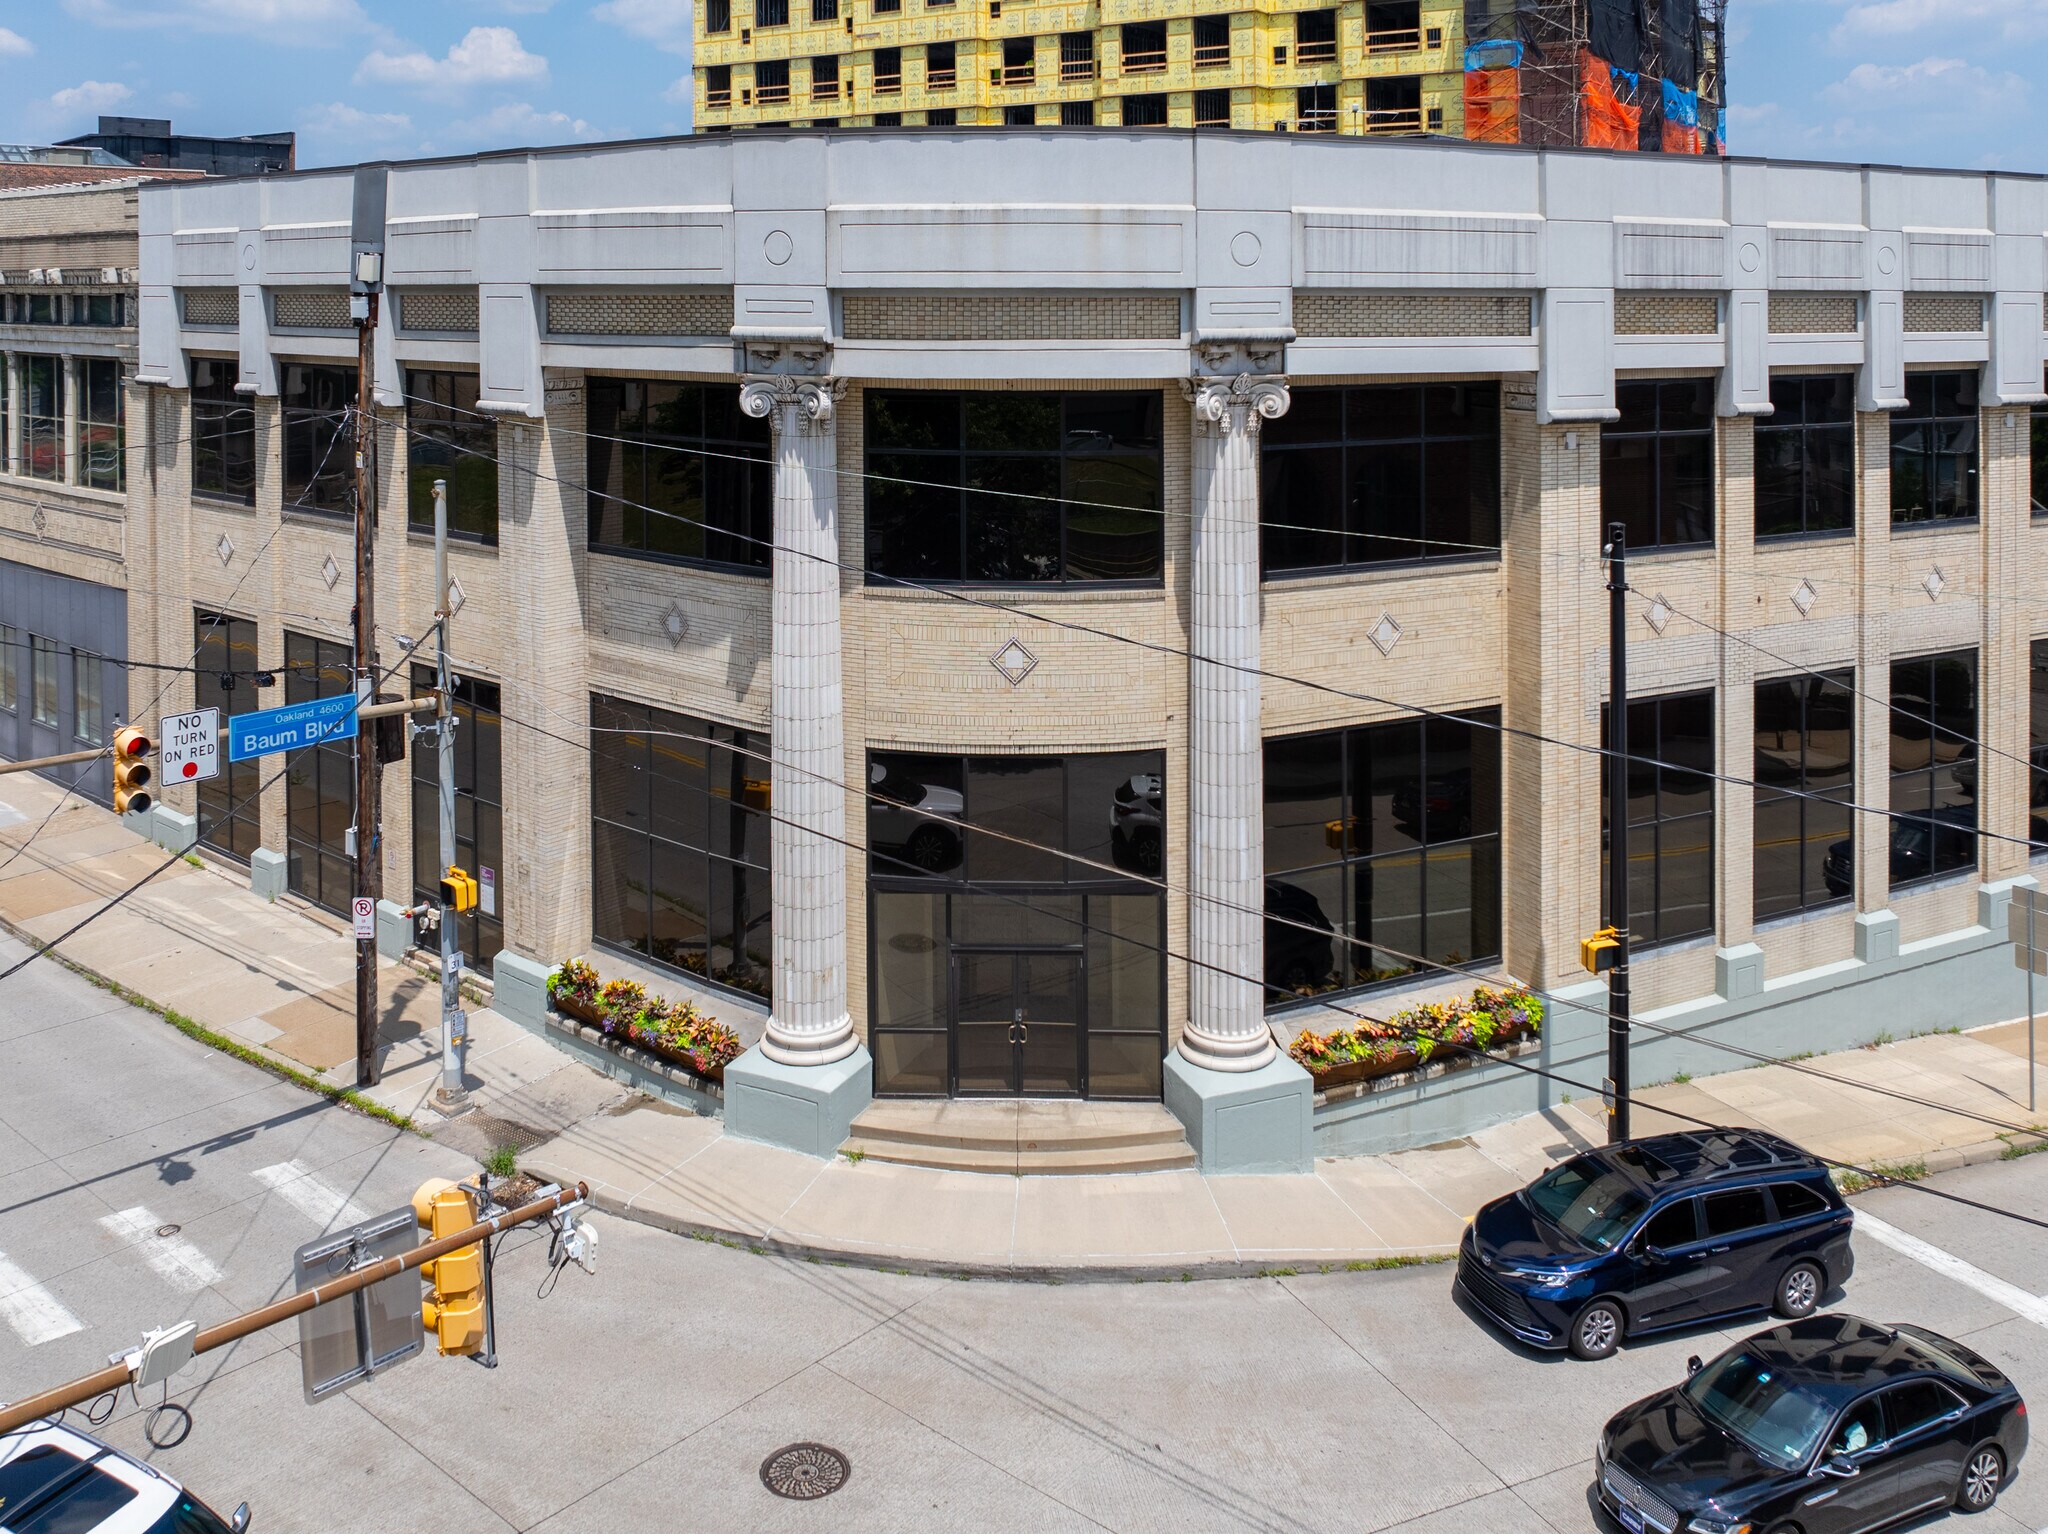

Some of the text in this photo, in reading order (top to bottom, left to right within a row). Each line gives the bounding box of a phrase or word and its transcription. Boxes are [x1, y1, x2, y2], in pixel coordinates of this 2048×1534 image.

[178, 715, 201, 731] NO
[275, 702, 344, 724] Oakland 4600
[173, 730, 207, 746] TURN
[244, 716, 344, 752] Baum Blvd
[164, 743, 215, 763] ON RED
